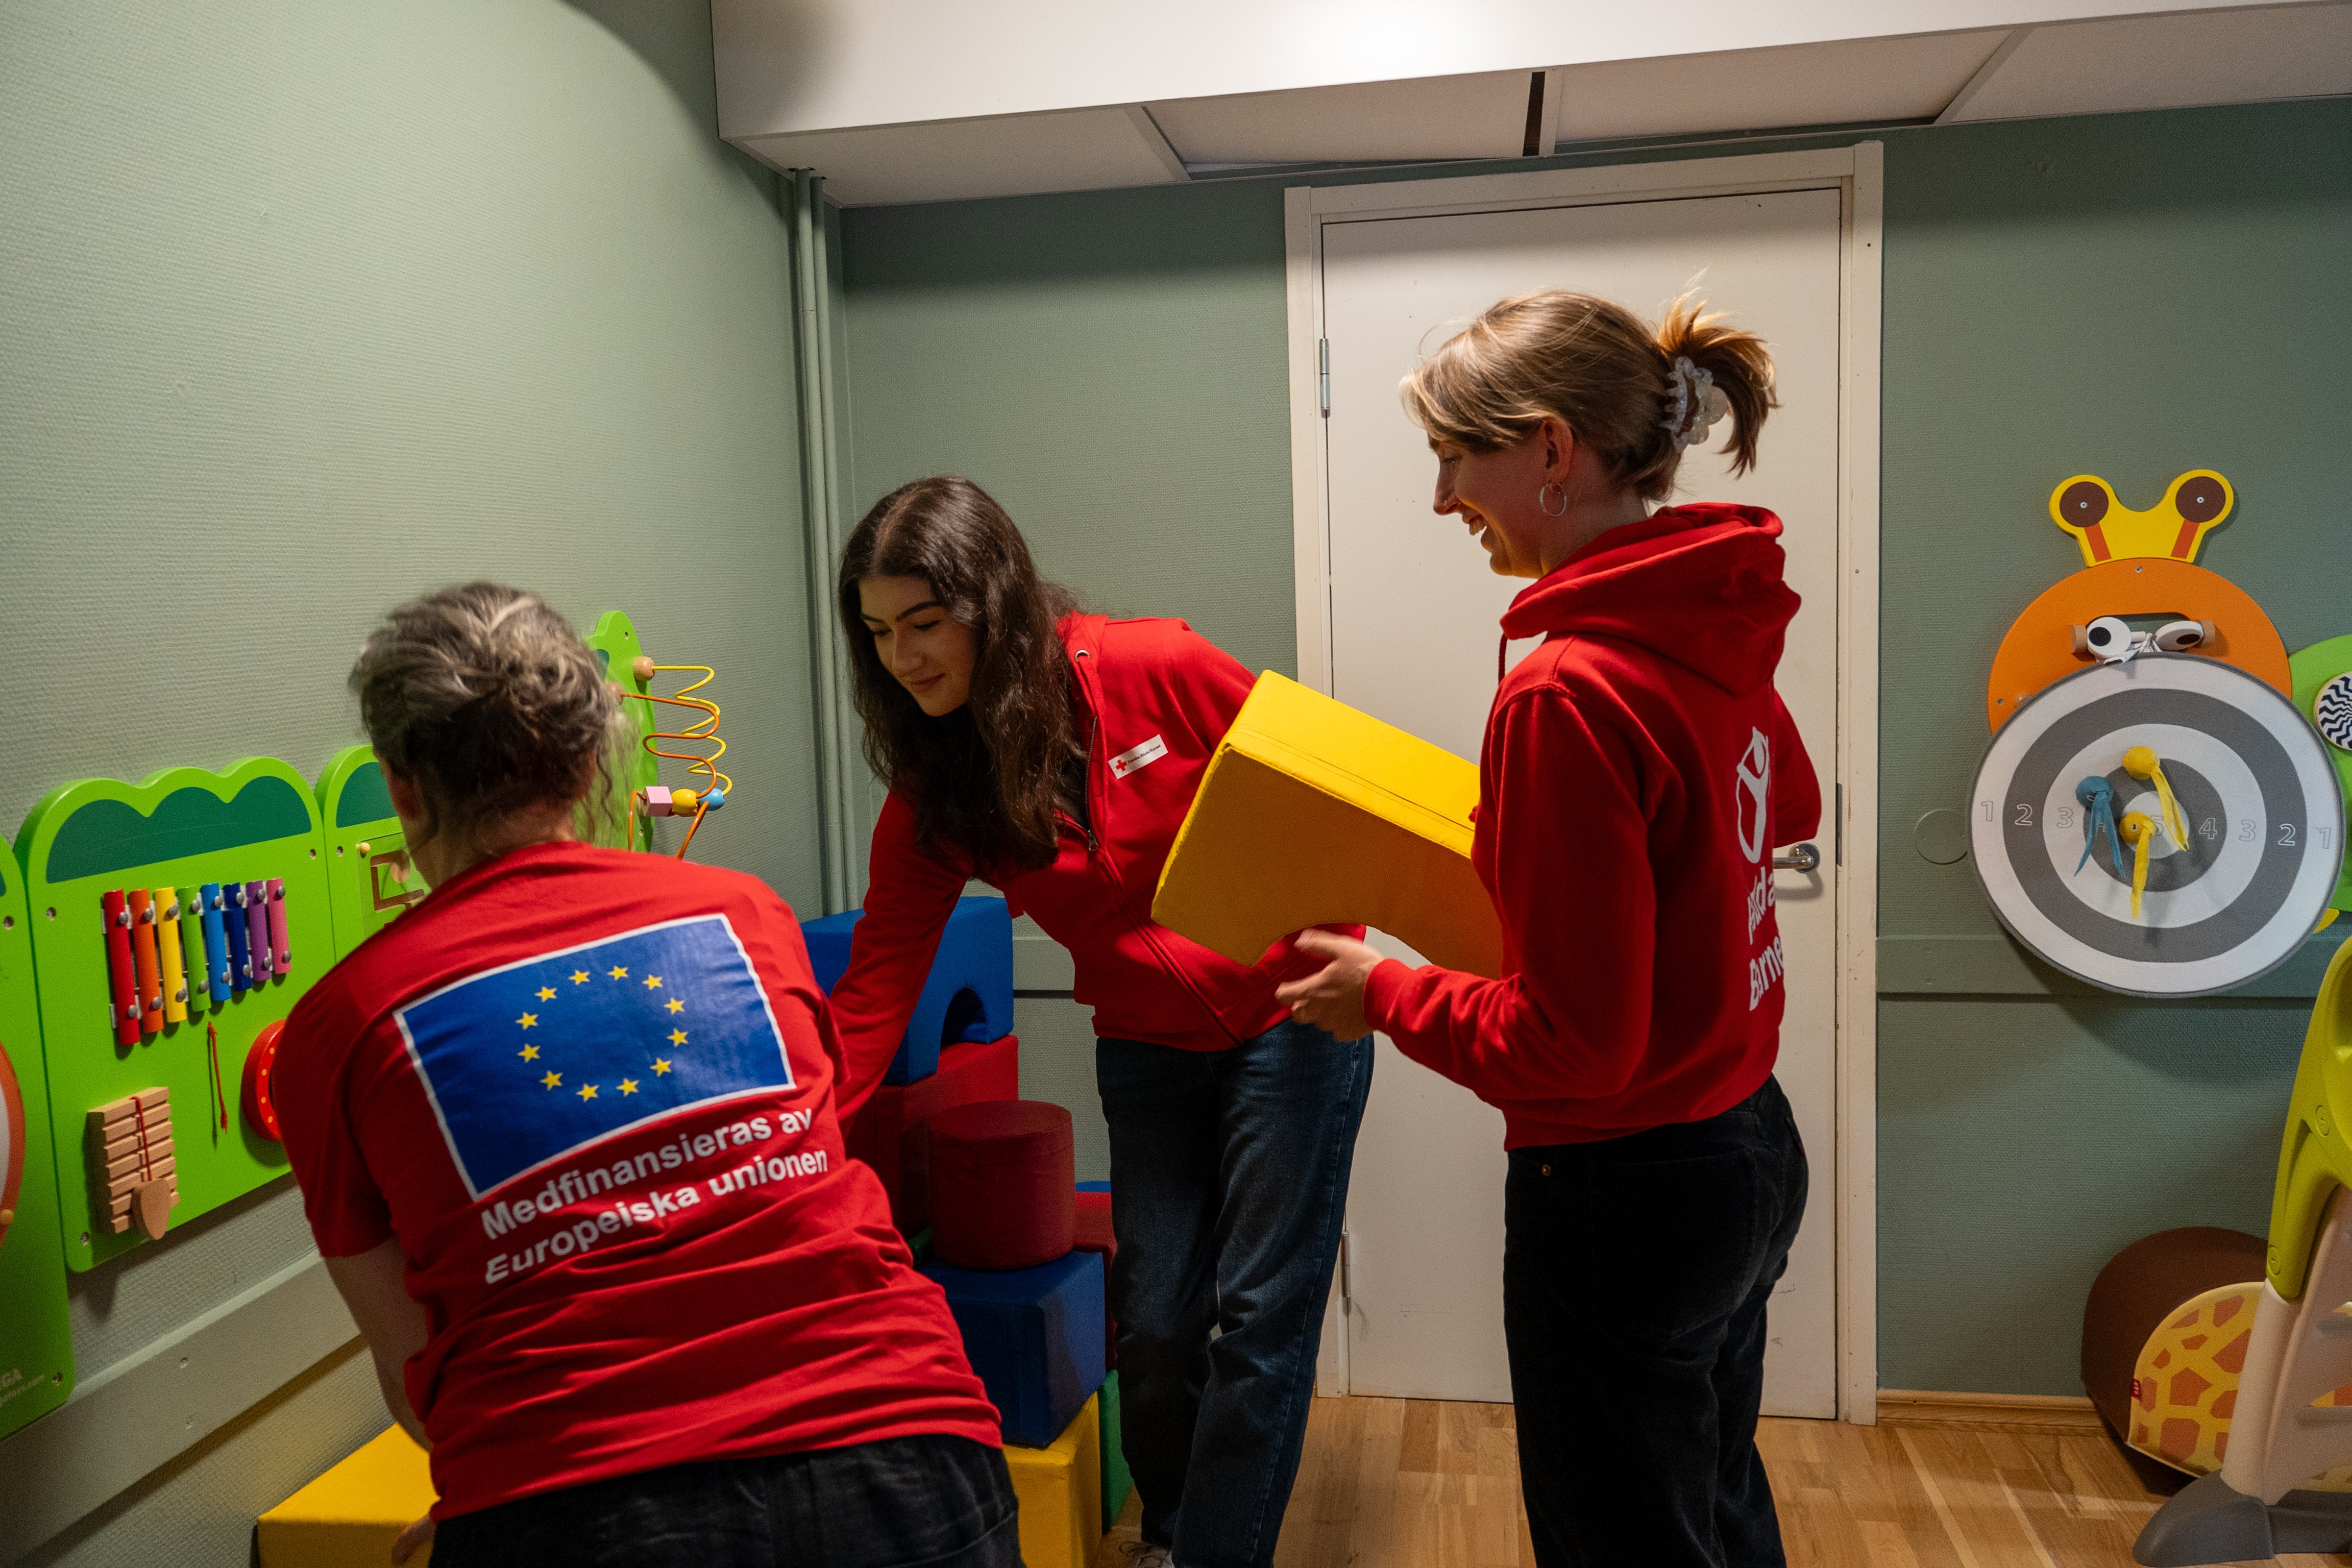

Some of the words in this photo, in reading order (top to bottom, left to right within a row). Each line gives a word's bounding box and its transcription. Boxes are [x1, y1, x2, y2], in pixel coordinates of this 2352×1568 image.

[1981, 800, 1993, 822] 1
[2015, 803, 2032, 826] 2
[2056, 807, 2073, 828] 3
[2199, 817, 2218, 840] 4
[2239, 820, 2256, 842] 3
[2277, 823, 2296, 846] 2
[2319, 826, 2332, 850] 1
[481, 1115, 772, 1240] Medfinansieras
[779, 1108, 813, 1133] av
[485, 1186, 700, 1285] Europeiska
[709, 1149, 828, 1197] unionen
